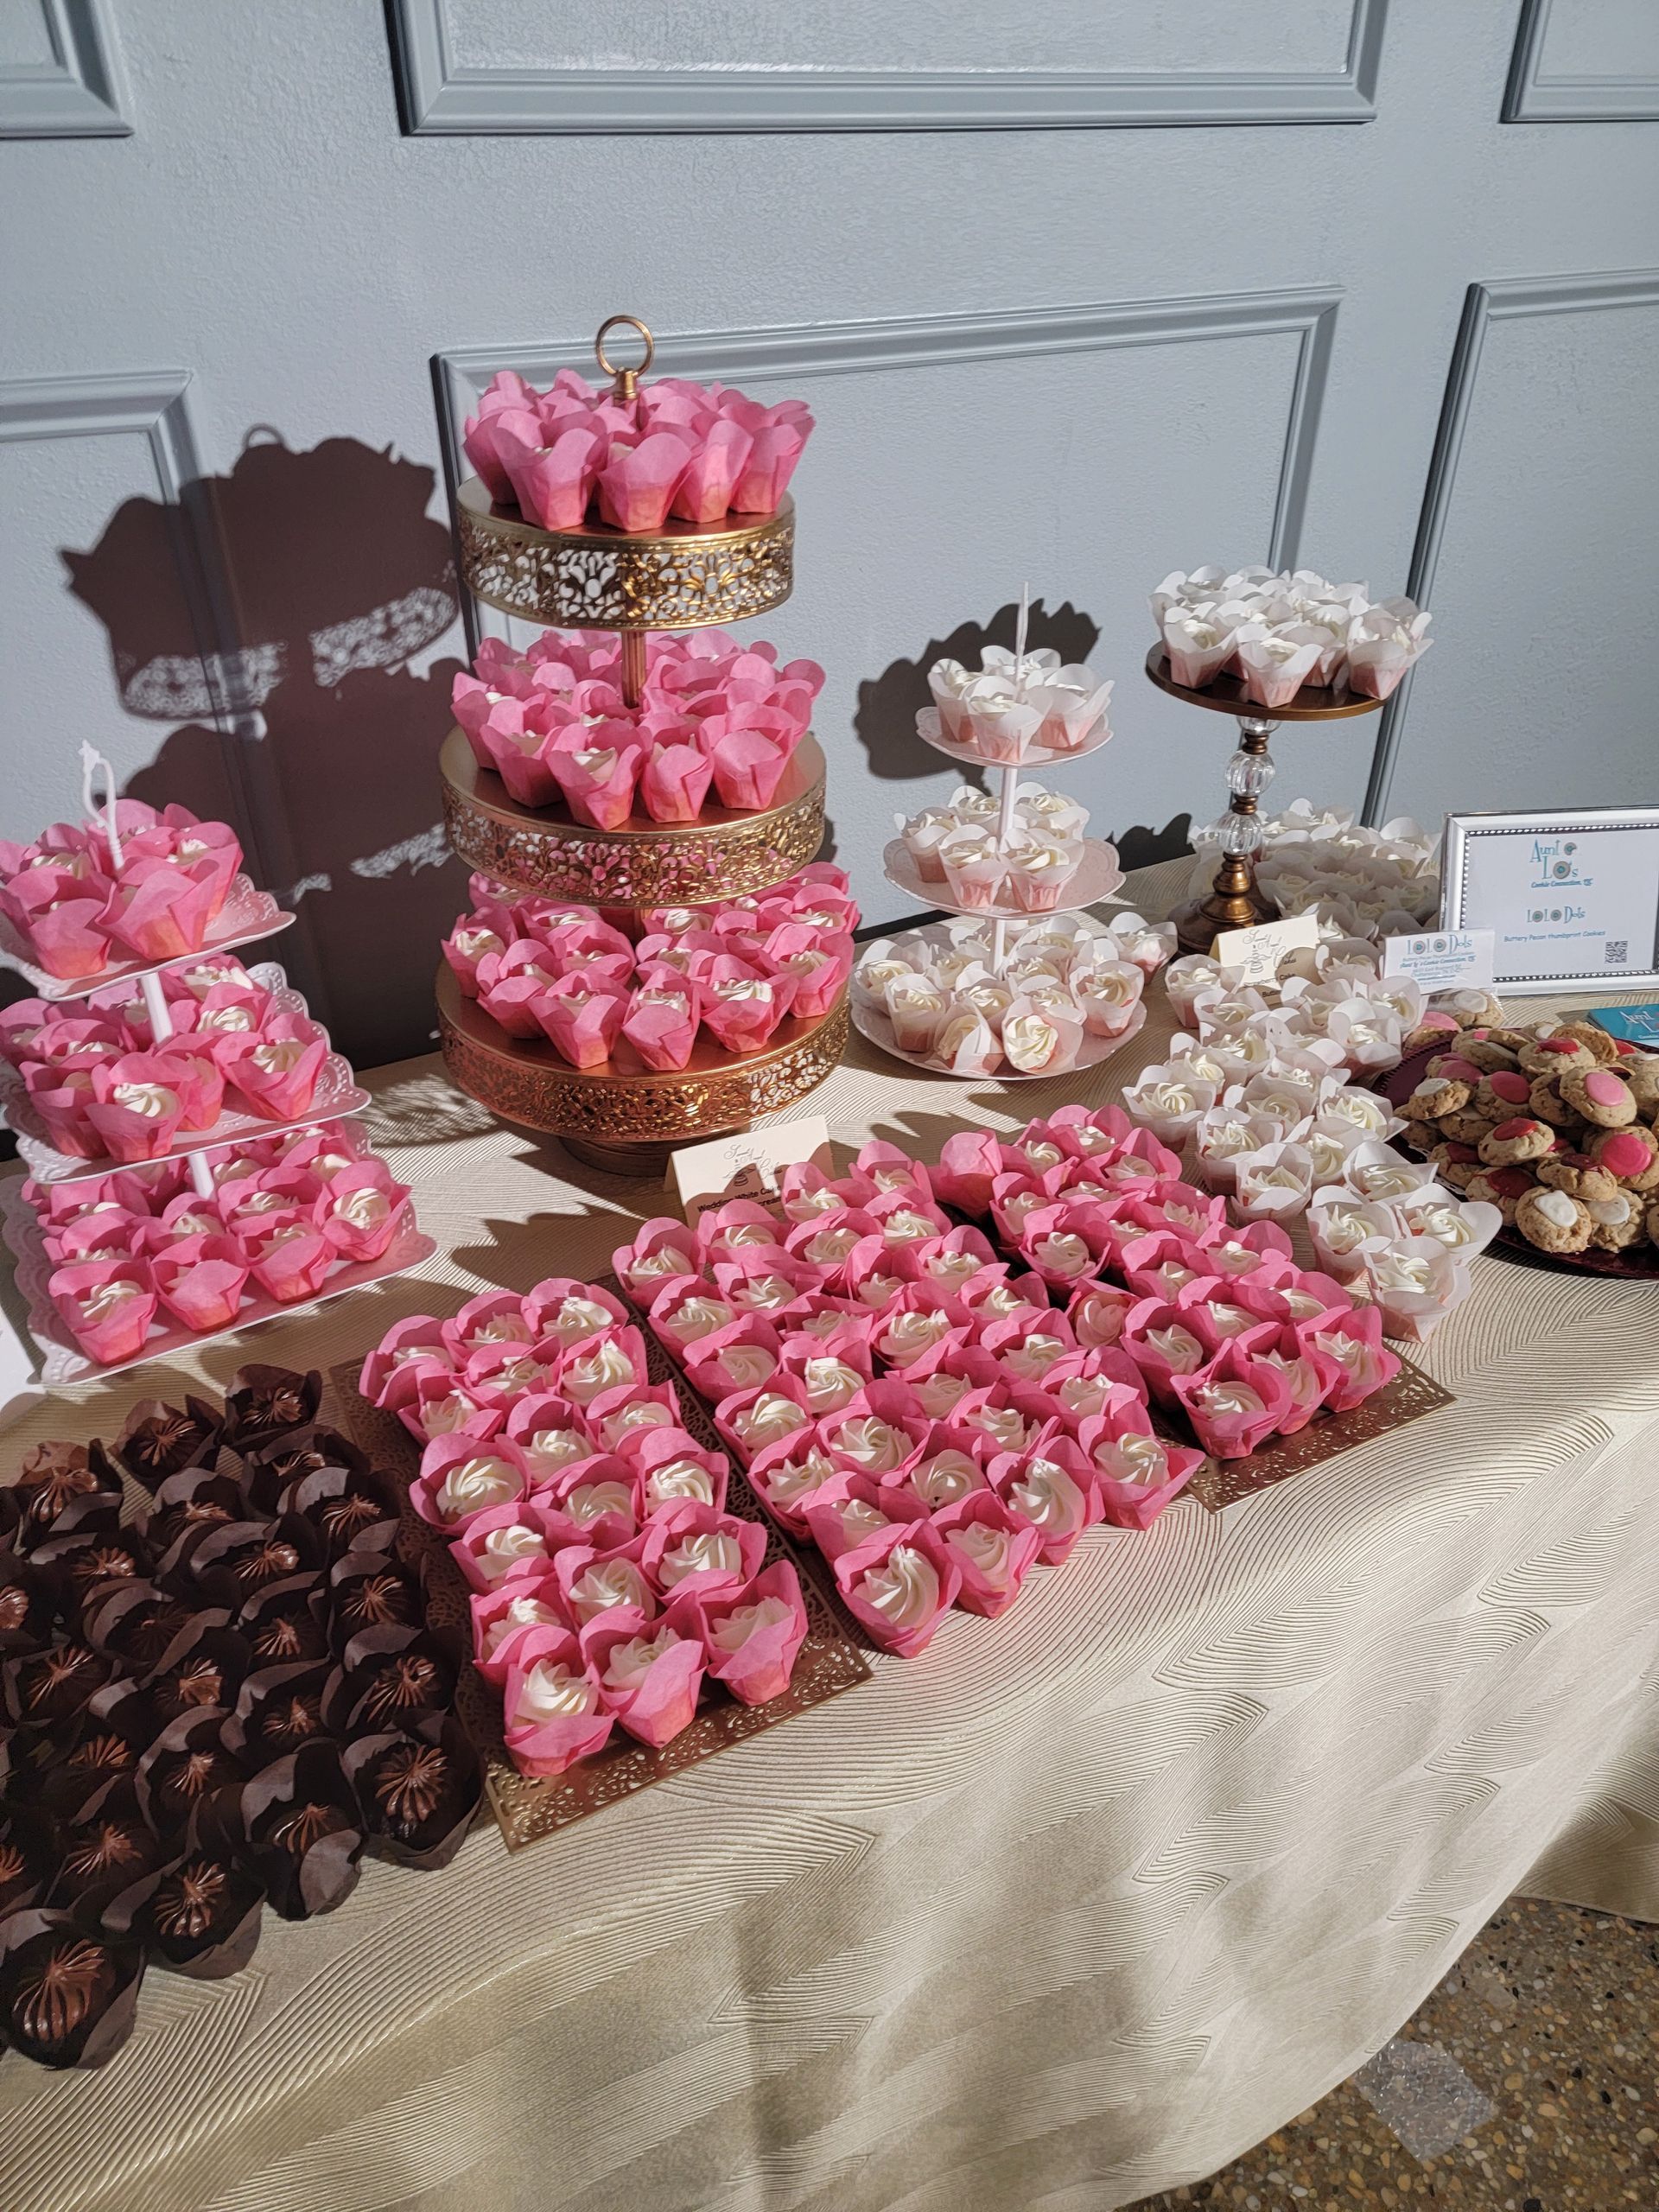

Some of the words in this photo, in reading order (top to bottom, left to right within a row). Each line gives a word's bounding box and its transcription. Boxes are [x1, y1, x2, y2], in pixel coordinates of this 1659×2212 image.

[1529, 838, 1560, 862] Aunt
[1563, 906, 1586, 924] Dots
[1449, 935, 1472, 954] Dots
